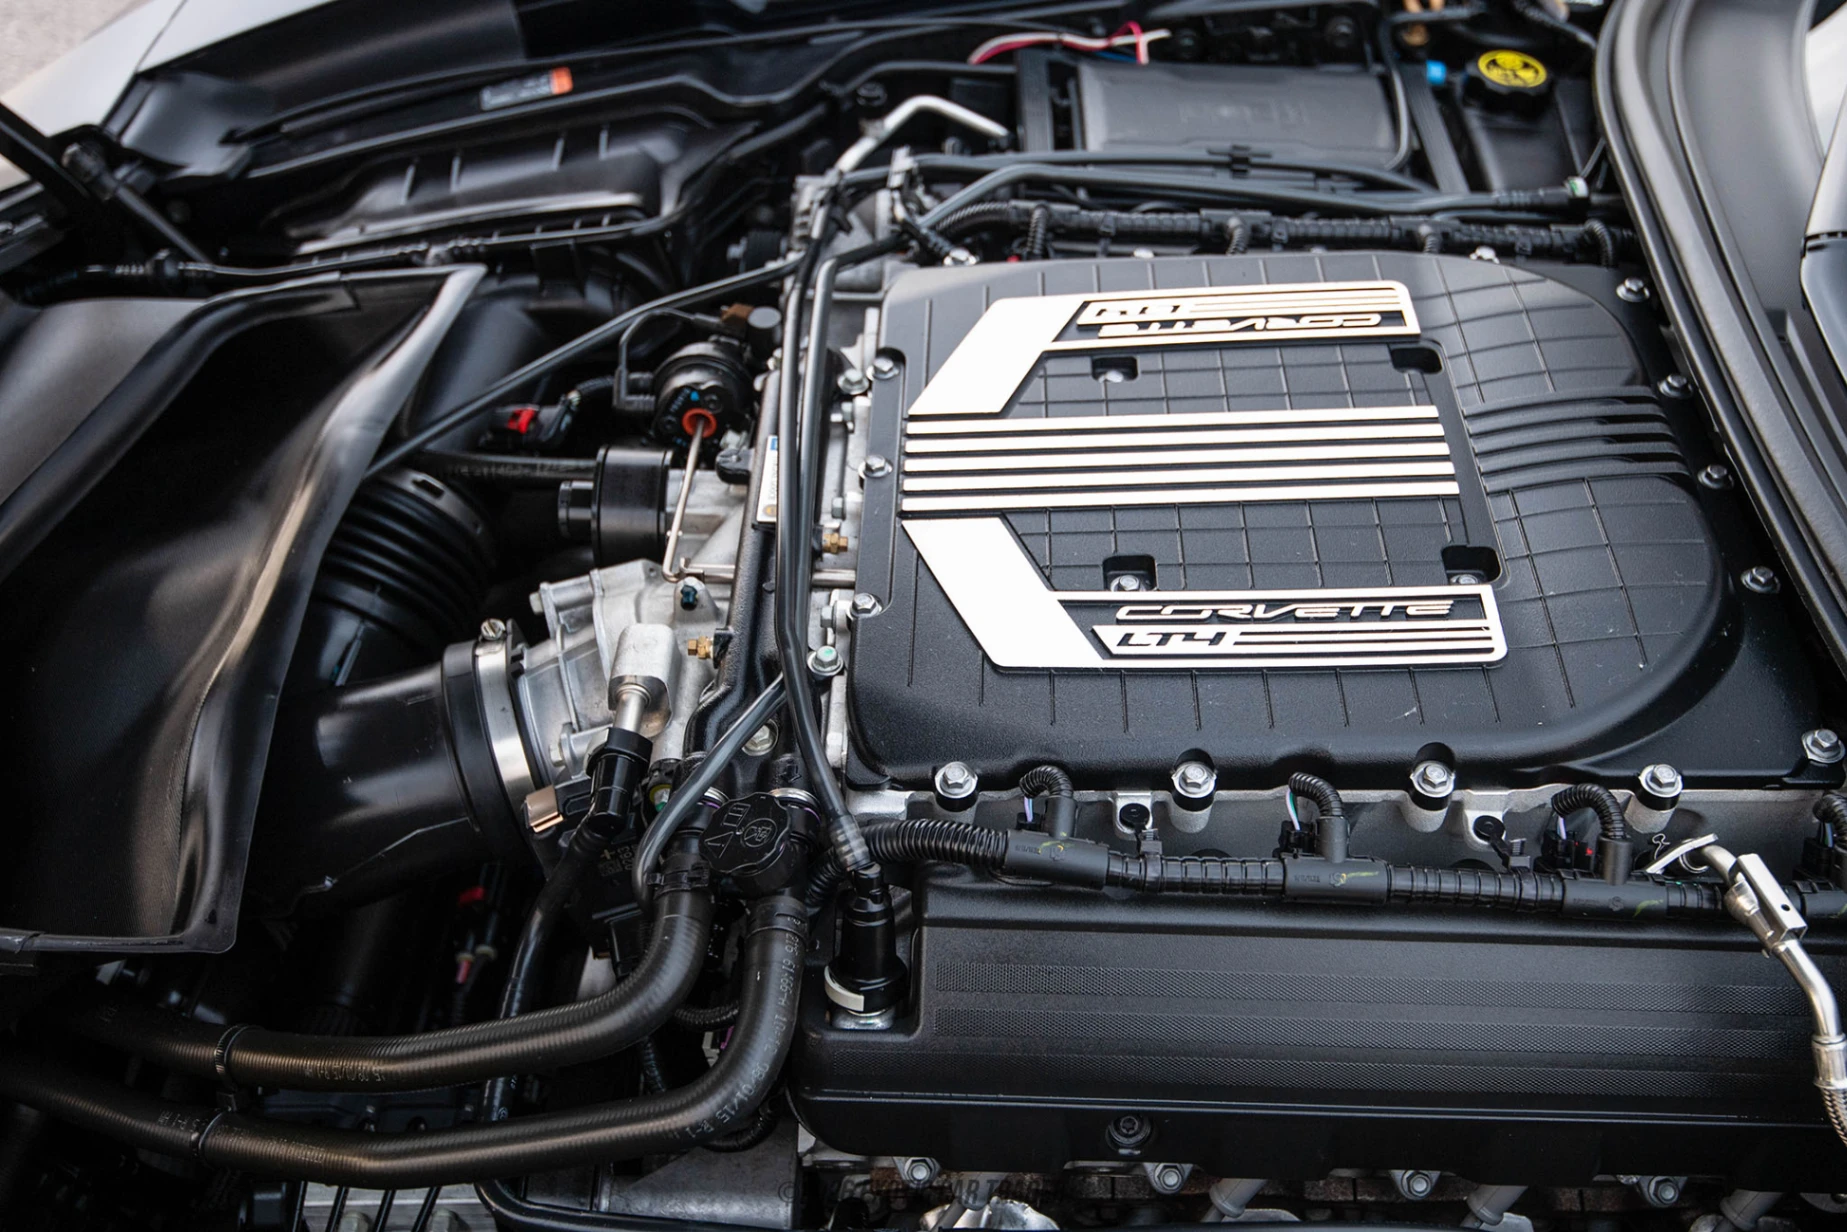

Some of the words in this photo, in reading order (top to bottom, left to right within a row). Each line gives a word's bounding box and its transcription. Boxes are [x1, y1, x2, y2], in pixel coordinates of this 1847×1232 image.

[1098, 313, 1381, 338] CORVETTE
[1116, 599, 1454, 620] CORVETTE
[1116, 631, 1227, 647] LT4
